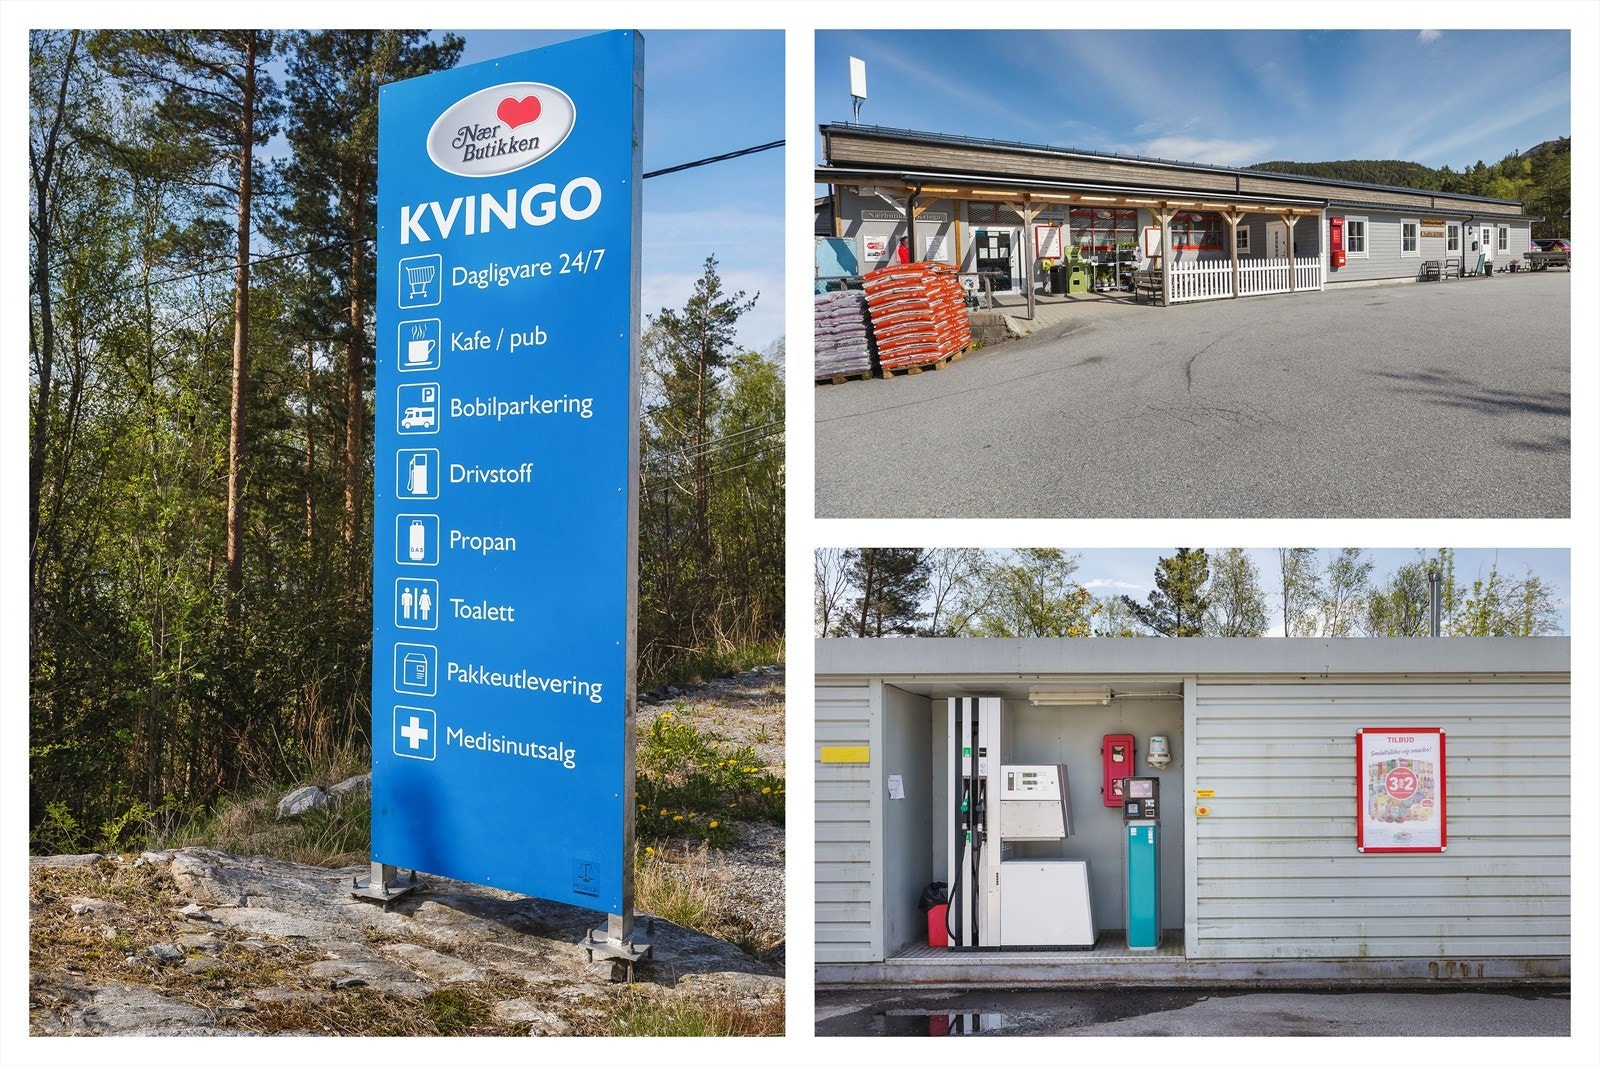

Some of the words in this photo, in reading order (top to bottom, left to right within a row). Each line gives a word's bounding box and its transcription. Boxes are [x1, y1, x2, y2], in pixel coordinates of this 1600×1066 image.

[451, 123, 501, 149] Nær
[462, 134, 540, 163] Butikken
[400, 176, 603, 245] KVINGO
[452, 261, 552, 289] Dagligvare
[559, 248, 606, 274] 24/7
[451, 331, 491, 352] Kafe
[495, 328, 504, 351] /
[510, 325, 548, 353] pub
[424, 389, 433, 401] P
[450, 394, 594, 422] Bobilparkering
[450, 463, 534, 483] Drivstoff
[450, 529, 516, 556] Propan
[449, 598, 515, 622] Toalett
[447, 661, 603, 704] Pakkeutlevering
[446, 726, 576, 769] Medisinutsalg
[1389, 776, 1399, 791] 3
[1404, 776, 1414, 791] 2
